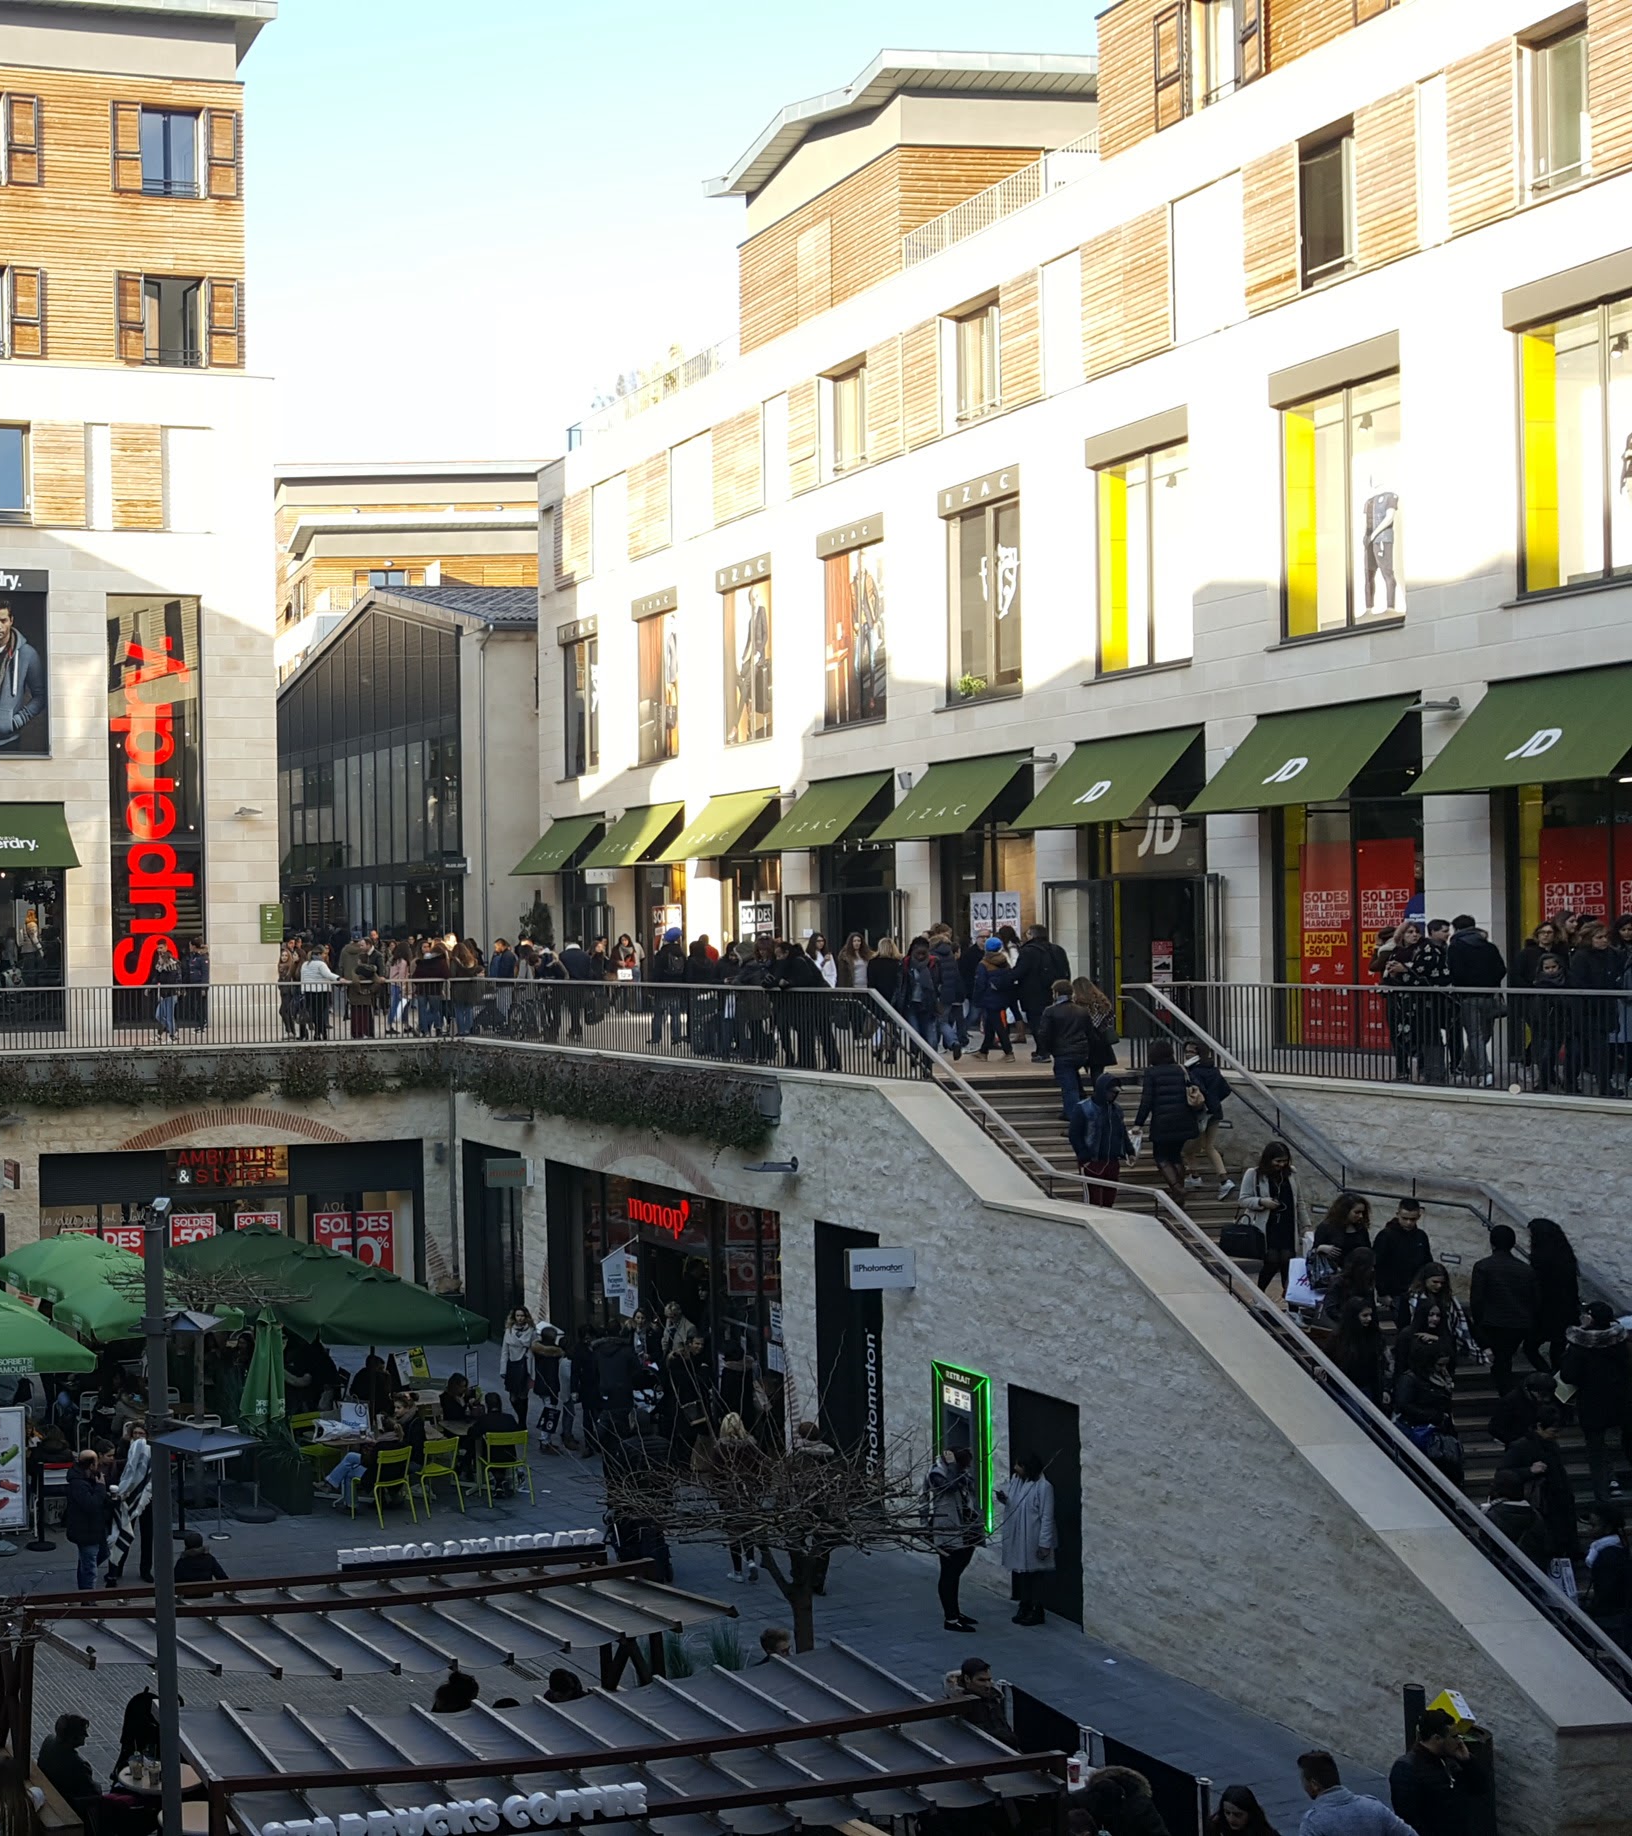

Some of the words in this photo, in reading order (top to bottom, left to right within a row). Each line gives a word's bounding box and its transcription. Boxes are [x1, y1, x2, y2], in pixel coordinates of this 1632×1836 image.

[945, 473, 1010, 510] IZAC
[831, 524, 869, 547] IZAC
[718, 558, 766, 587] IZAC
[1504, 727, 1563, 761] JD
[1262, 756, 1309, 785] JD
[1072, 780, 1112, 805] JD
[110, 635, 194, 986] Superdry.
[906, 803, 967, 821] IZAC
[787, 818, 837, 833] IZAC
[1137, 804, 1183, 858] JD
[687, 831, 730, 844] IZAC
[604, 841, 640, 853] IZAC
[533, 850, 564, 860] IZAC
[1362, 890, 1409, 902] SOLDES
[1546, 883, 1602, 897] SOLDES
[1304, 891, 1348, 904] SOLDES
[973, 902, 1017, 920] SOLDES
[1320, 903, 1335, 911] LES
[1362, 903, 1378, 911] SUR
[1304, 911, 1349, 920] MEILLEURES
[1362, 910, 1406, 919] MEILLEURE
[1304, 919, 1341, 928] MARQUES
[1305, 945, 1331, 956] -50%
[173, 1216, 213, 1228] SOLDES
[319, 1216, 390, 1234] SOLDES
[857, 1263, 904, 1273] Photomaton
[945, 1370, 971, 1385] RETRAIT
[502, 1781, 647, 1827] COFFEE
